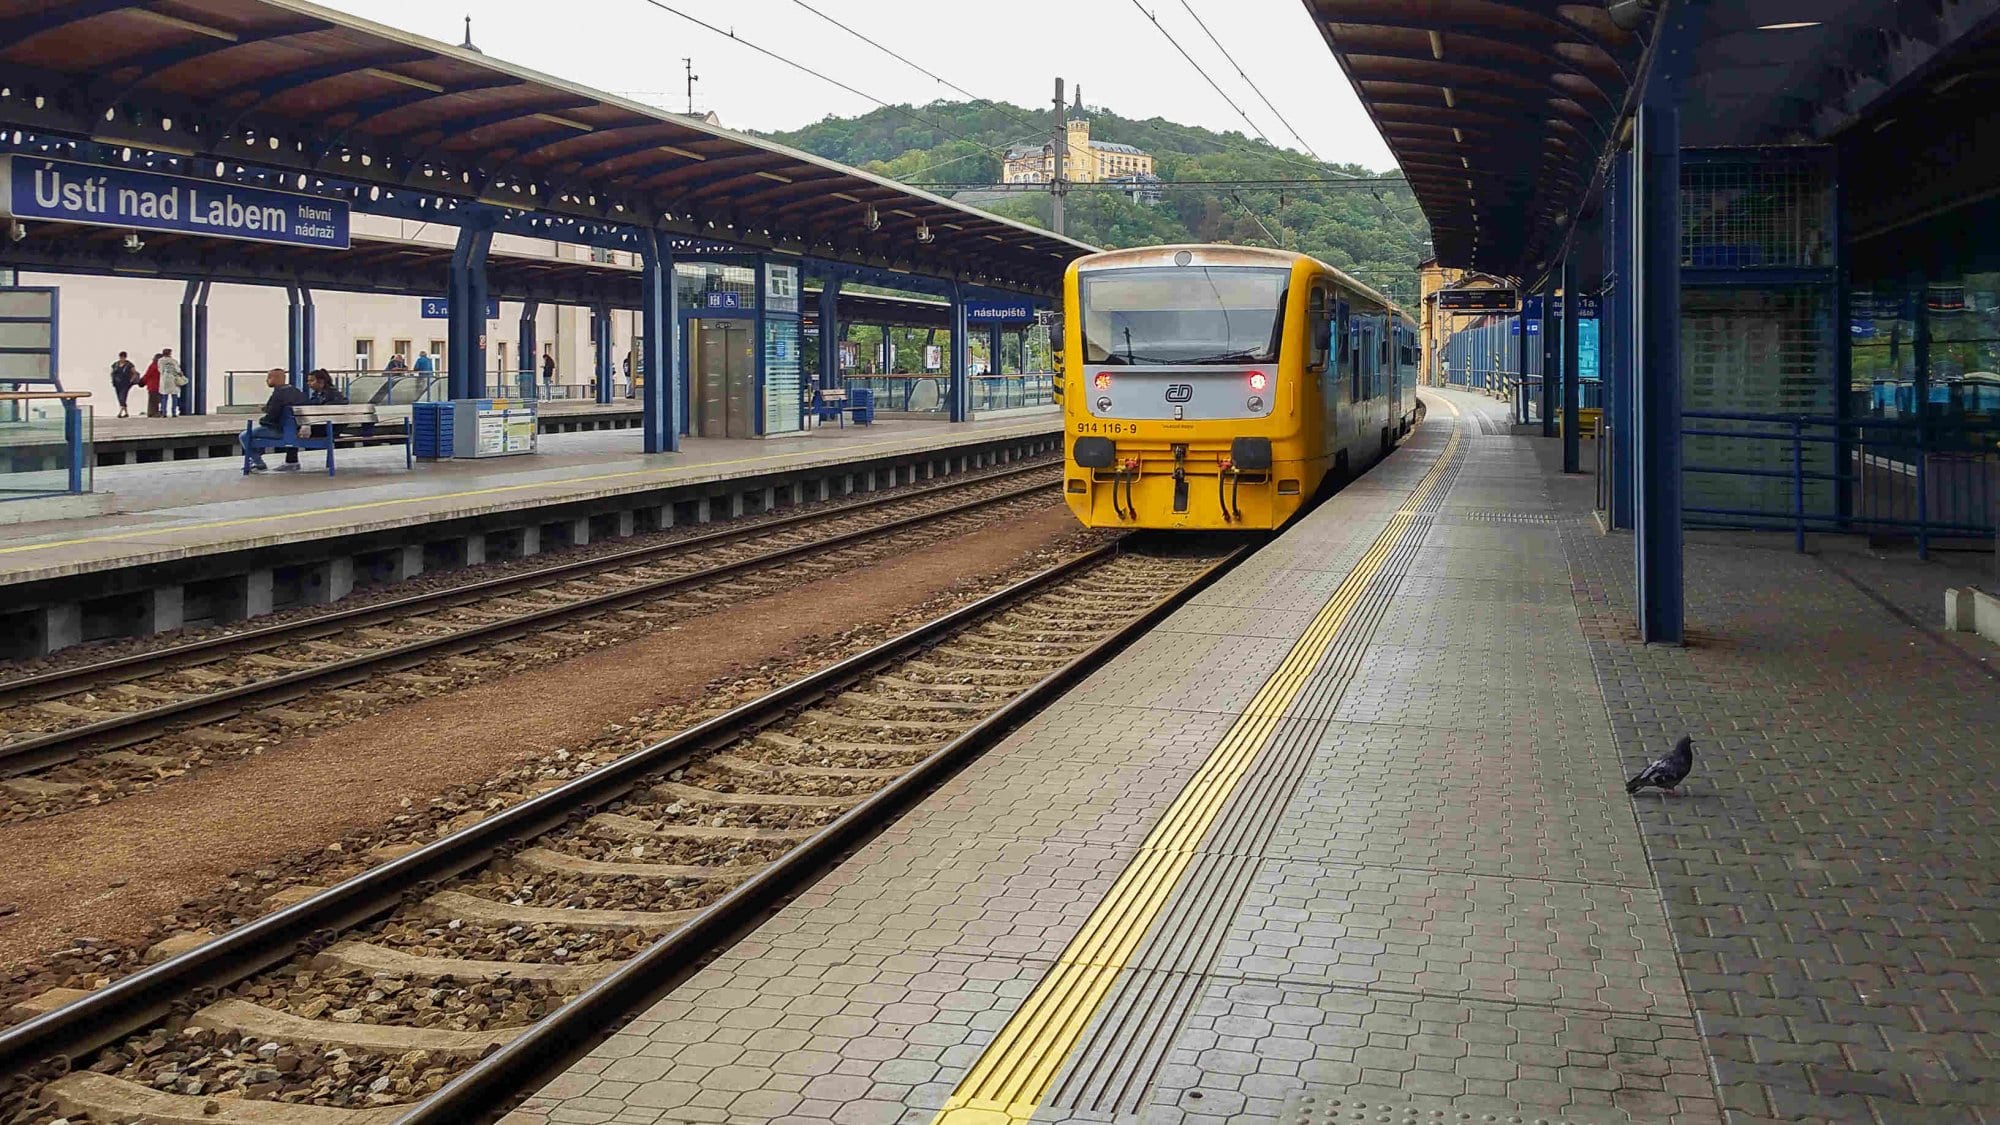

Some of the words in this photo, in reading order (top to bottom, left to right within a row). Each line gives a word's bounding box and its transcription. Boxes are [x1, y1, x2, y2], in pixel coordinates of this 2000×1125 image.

[35, 162, 107, 213] Ústí
[119, 187, 178, 220] nad
[189, 189, 286, 233] Labem
[298, 205, 332, 221] hlavní
[295, 223, 335, 239] nádraží
[428, 303, 439, 315] 3.
[973, 307, 1026, 318] nástupiště
[1077, 422, 1097, 433] 914
